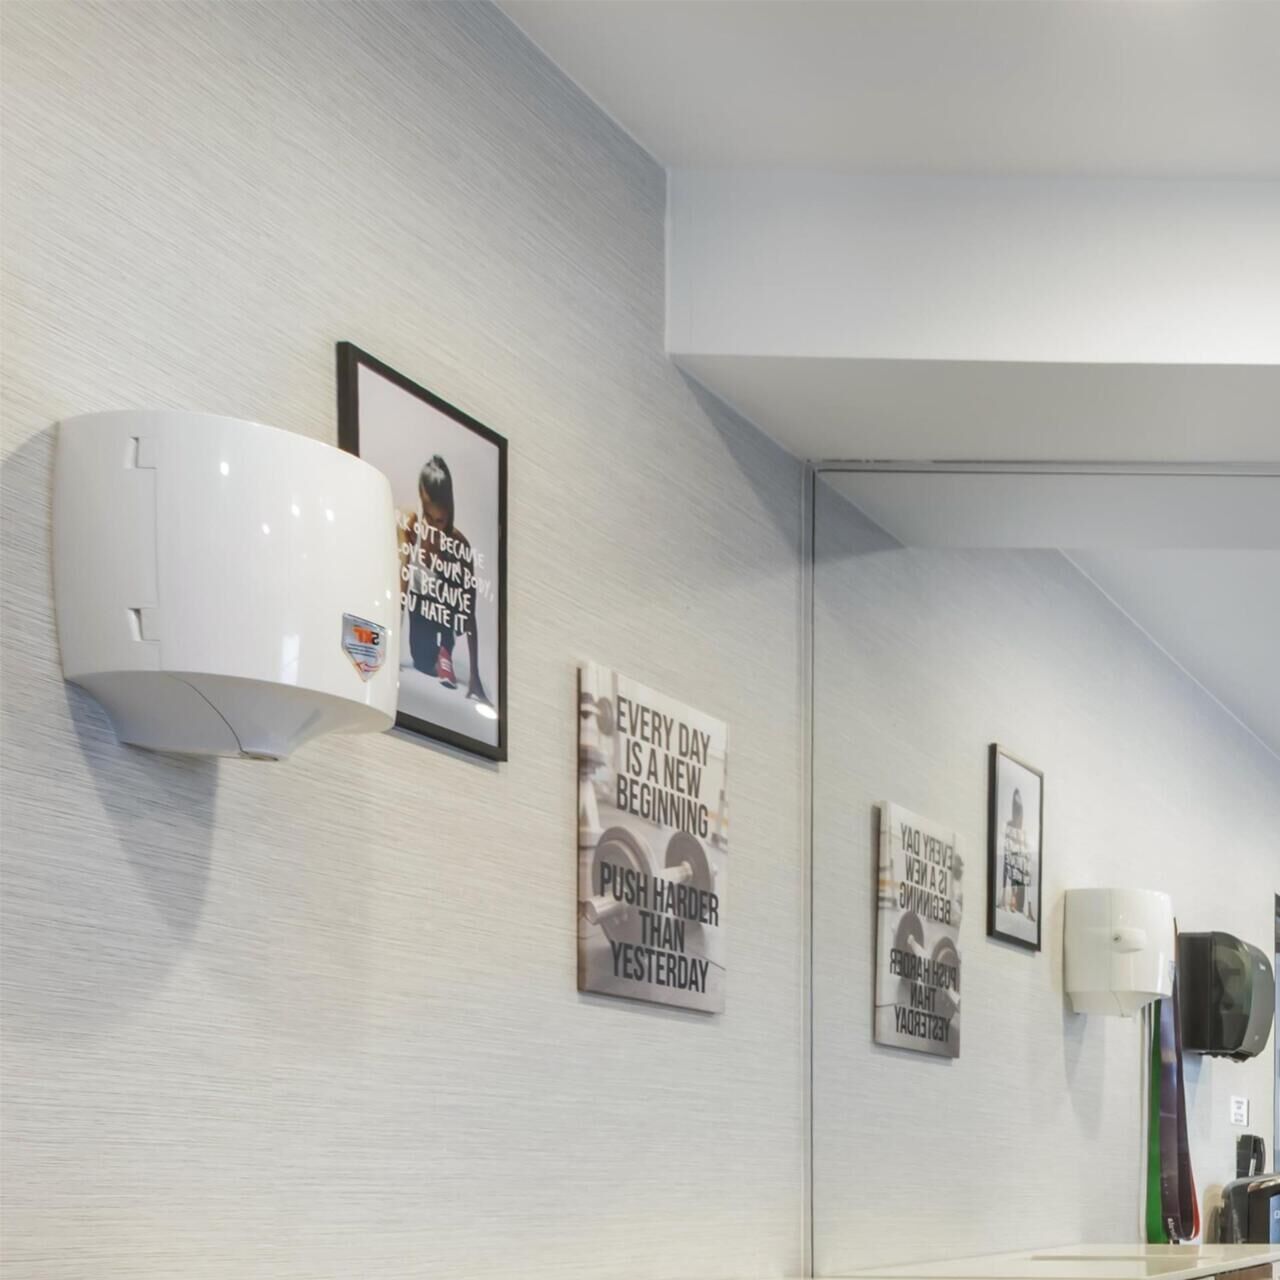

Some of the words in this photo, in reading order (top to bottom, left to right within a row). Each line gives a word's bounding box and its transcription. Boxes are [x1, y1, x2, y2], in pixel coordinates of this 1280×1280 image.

[413, 519, 438, 544] OUT
[440, 530, 484, 569] BECAUSE
[430, 552, 462, 584] YOUR
[401, 564, 418, 591] OT
[421, 571, 471, 613] BECAUSE
[421, 600, 451, 628] HATE
[616, 695, 674, 751] EVERY
[679, 722, 711, 767] DAY
[626, 738, 643, 777] IS
[647, 748, 659, 784] A
[664, 754, 701, 799] NEW
[616, 773, 709, 839] BEGINNING
[600, 861, 648, 908] PUSH
[653, 877, 719, 927] HARDER
[639, 910, 685, 953] THAN
[610, 940, 709, 993] YESTERDAY
